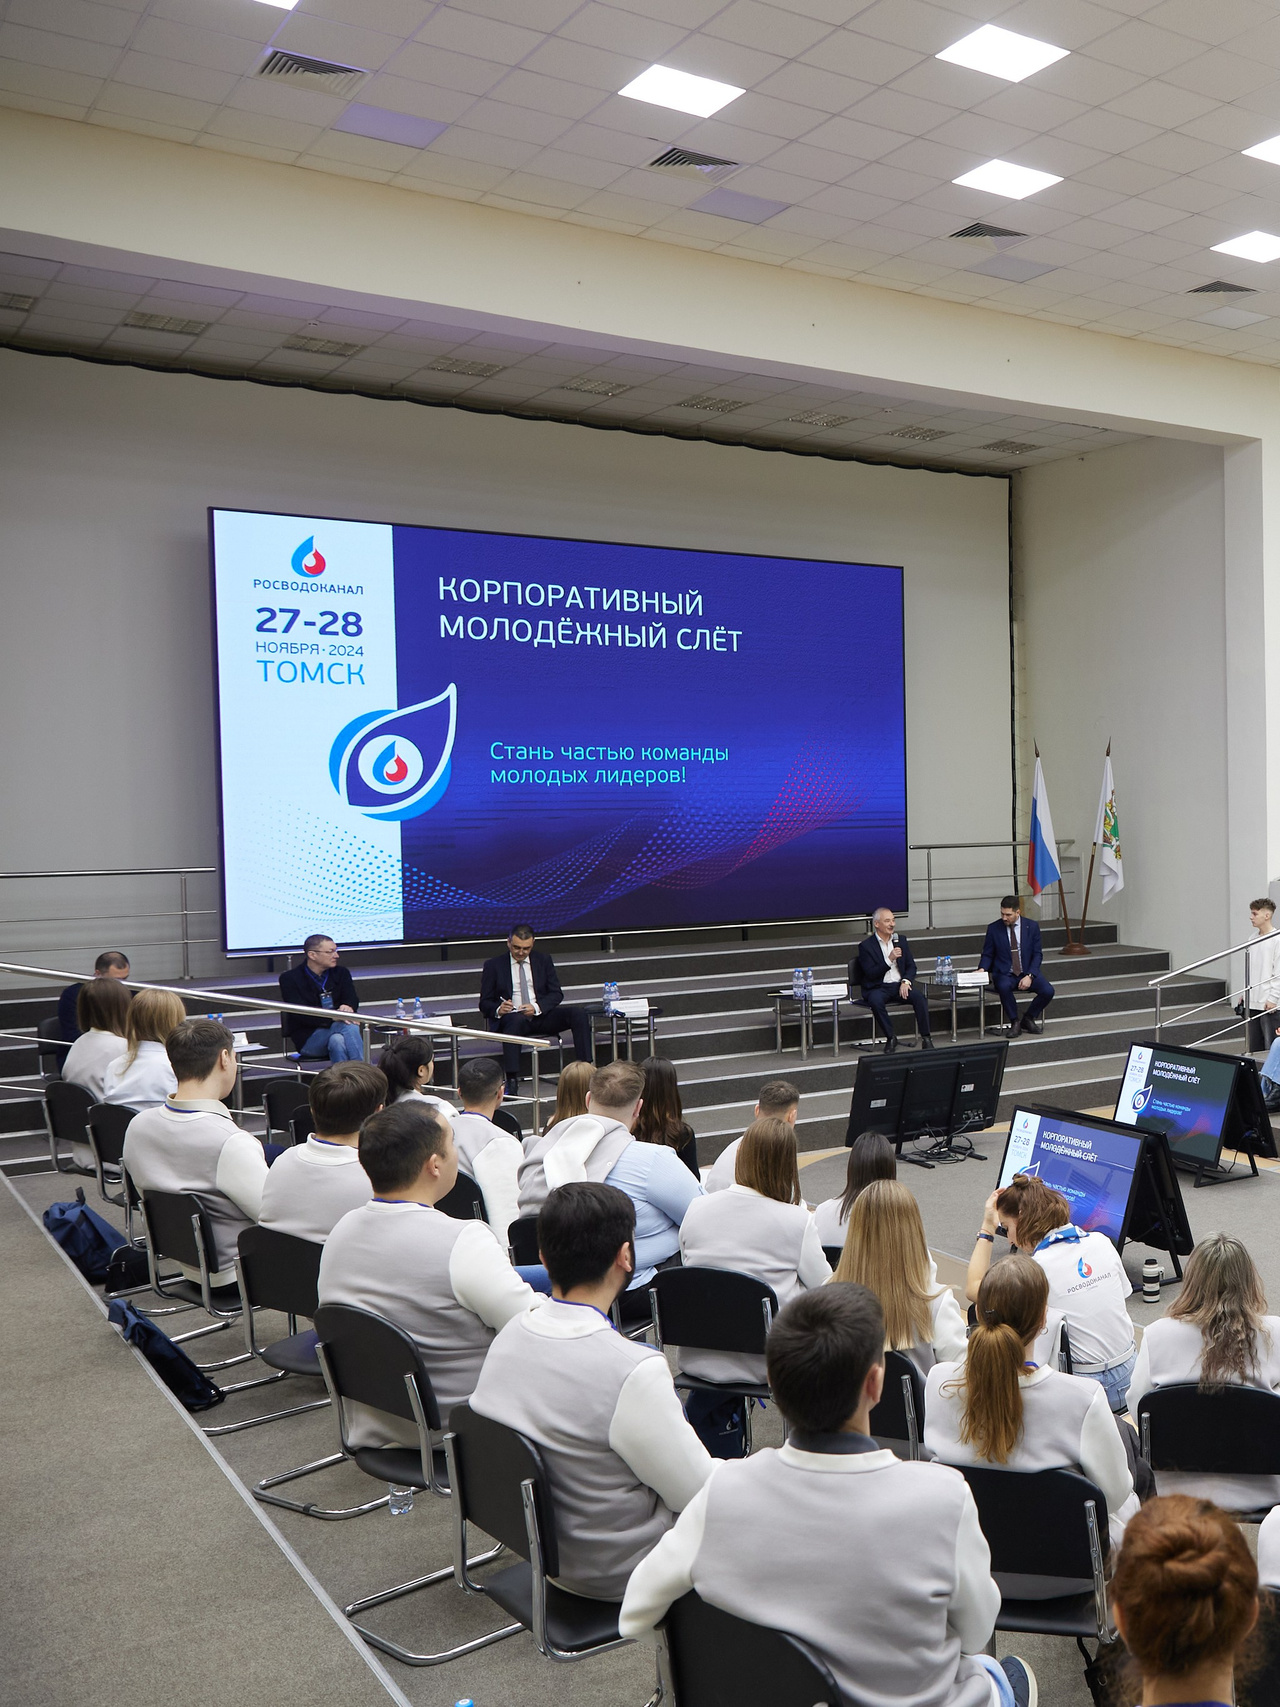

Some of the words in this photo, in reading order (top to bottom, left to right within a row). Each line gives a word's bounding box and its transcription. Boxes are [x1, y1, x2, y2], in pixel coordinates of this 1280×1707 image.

[253, 578, 364, 595] РОСВОДОКАНАЛ
[438, 576, 703, 617] КОРПОРАТИВНЫЙ
[256, 607, 364, 637] 27-28
[440, 613, 667, 649] МОЛОДЁЖНЫЙ
[676, 625, 743, 652] СЛЁТ
[255, 641, 320, 655] НОЯБРЯ
[328, 644, 364, 657] 2024
[256, 660, 365, 685] ТОМСК
[489, 741, 554, 760] Стань
[561, 745, 634, 761] частью
[641, 746, 729, 764] команды
[490, 768, 588, 787] молодых
[594, 766, 687, 787] лидеров!
[1042, 1130, 1093, 1150] КОРПОРАТИВНЫЙ
[1040, 1141, 1083, 1159] МОЛОДЁЖНЫЙ
[1082, 1149, 1098, 1163] СЛЁТ
[1067, 1272, 1112, 1294] РОСВОДОКАНАЛ
